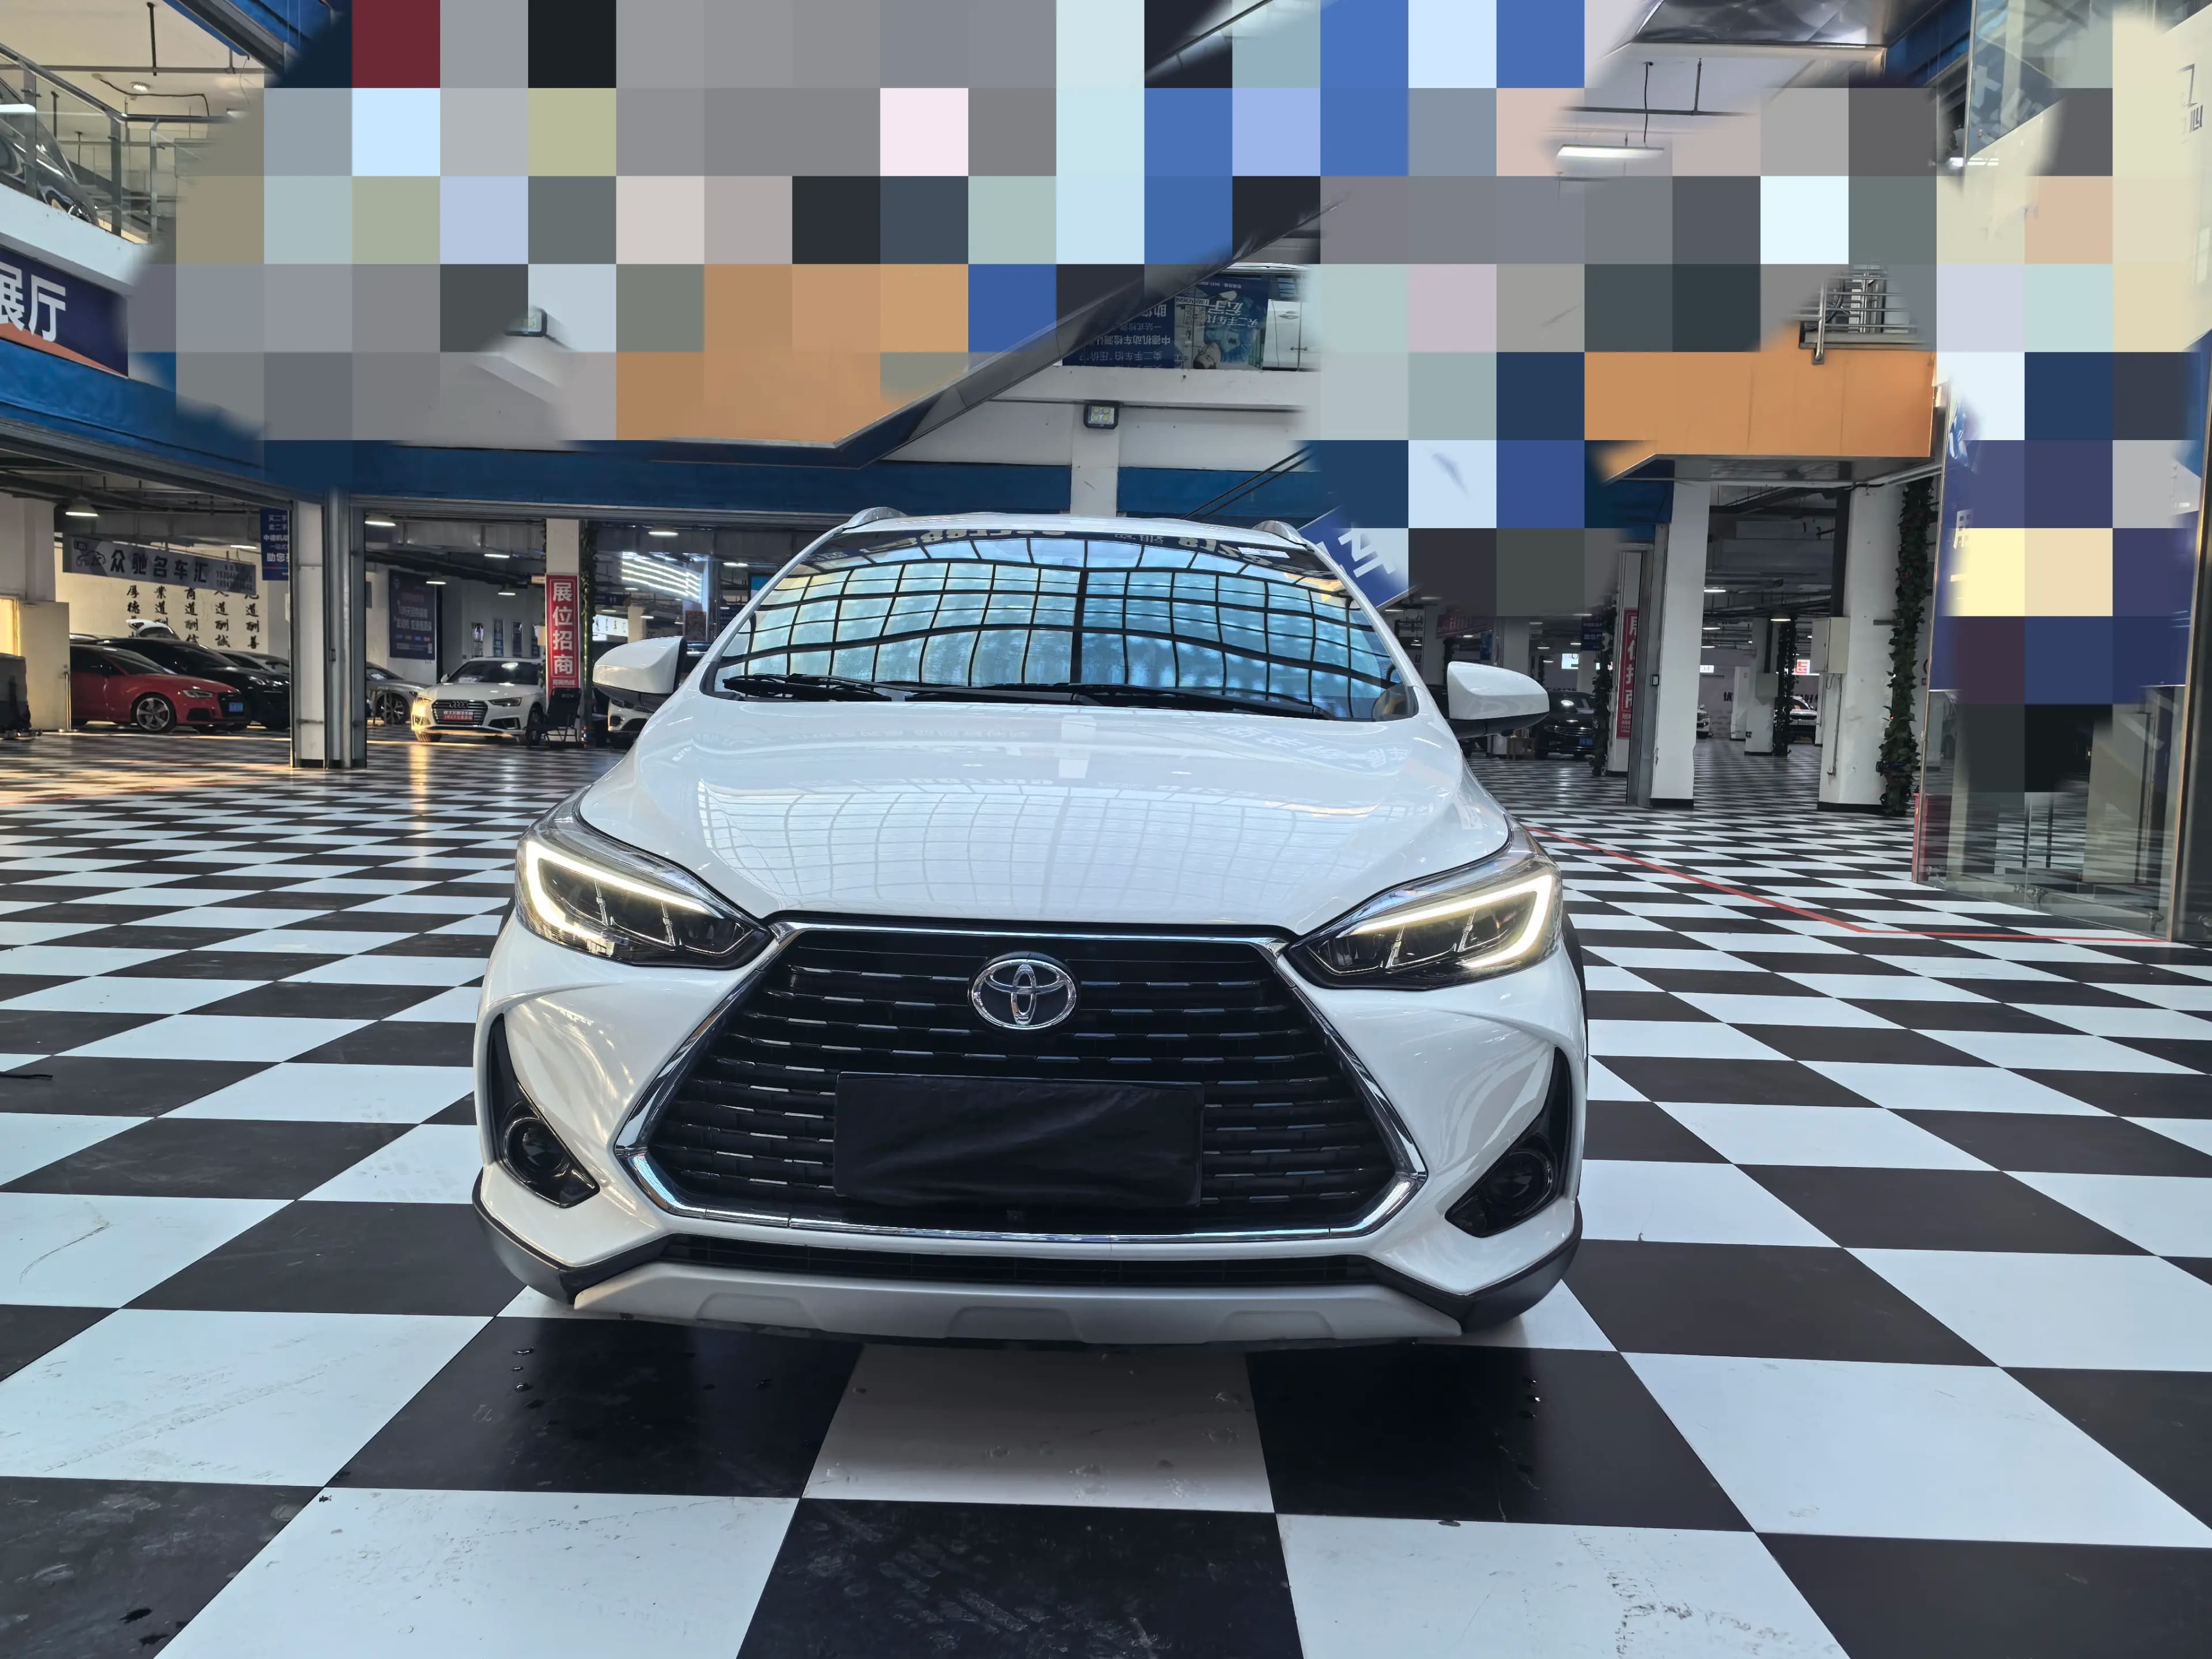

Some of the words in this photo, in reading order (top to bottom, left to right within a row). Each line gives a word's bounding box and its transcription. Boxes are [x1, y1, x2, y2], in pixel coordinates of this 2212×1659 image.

[0, 260, 66, 342] 展厅
[110, 549, 209, 584] 众驰名车汇
[552, 582, 573, 675] 展位招商
